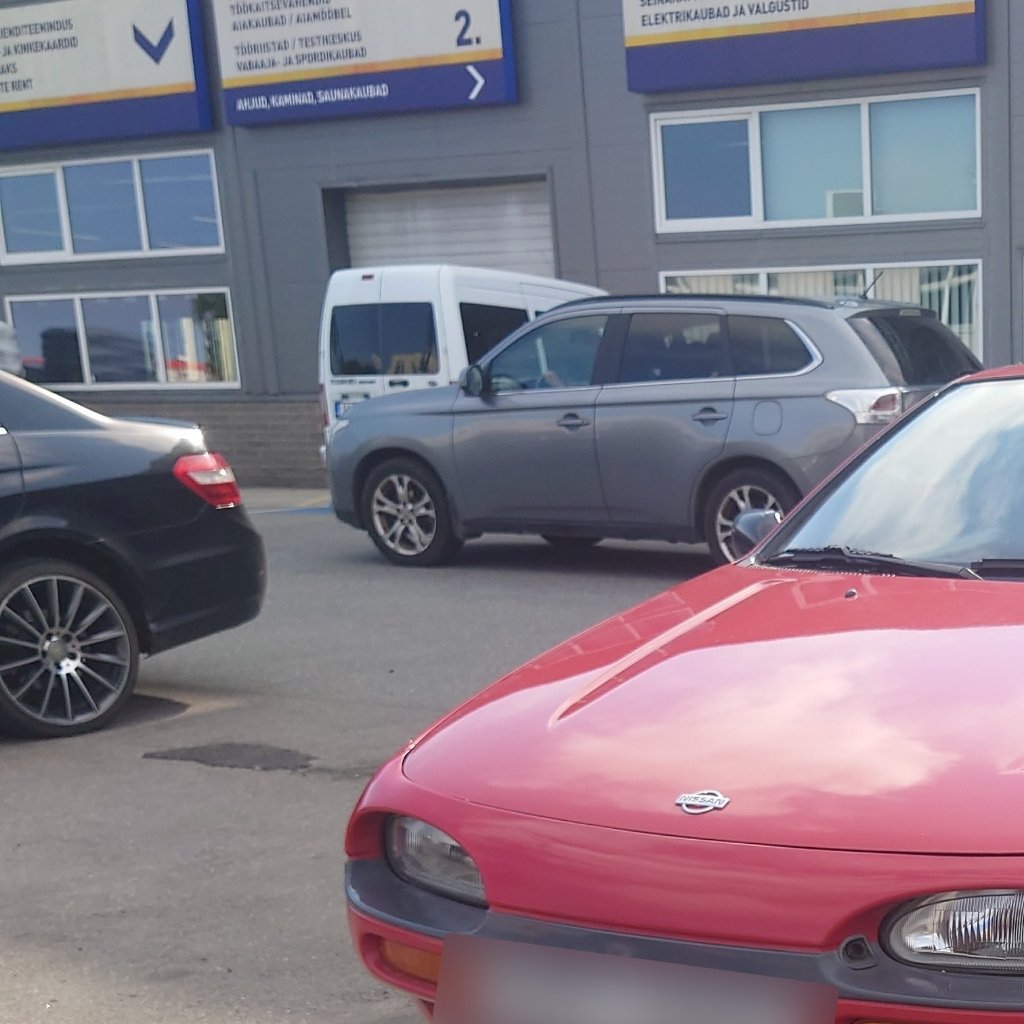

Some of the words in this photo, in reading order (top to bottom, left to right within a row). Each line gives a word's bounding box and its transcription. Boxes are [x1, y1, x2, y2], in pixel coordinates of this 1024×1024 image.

[641, 6, 730, 27] ELEKTRIKAUBAD
[731, 5, 746, 17] JA
[749, 0, 809, 15] VALGUSTID
[455, 9, 481, 47] 2.
[316, 83, 389, 103] SAUNAKAUBAD
[679, 795, 725, 805] NISSAN
